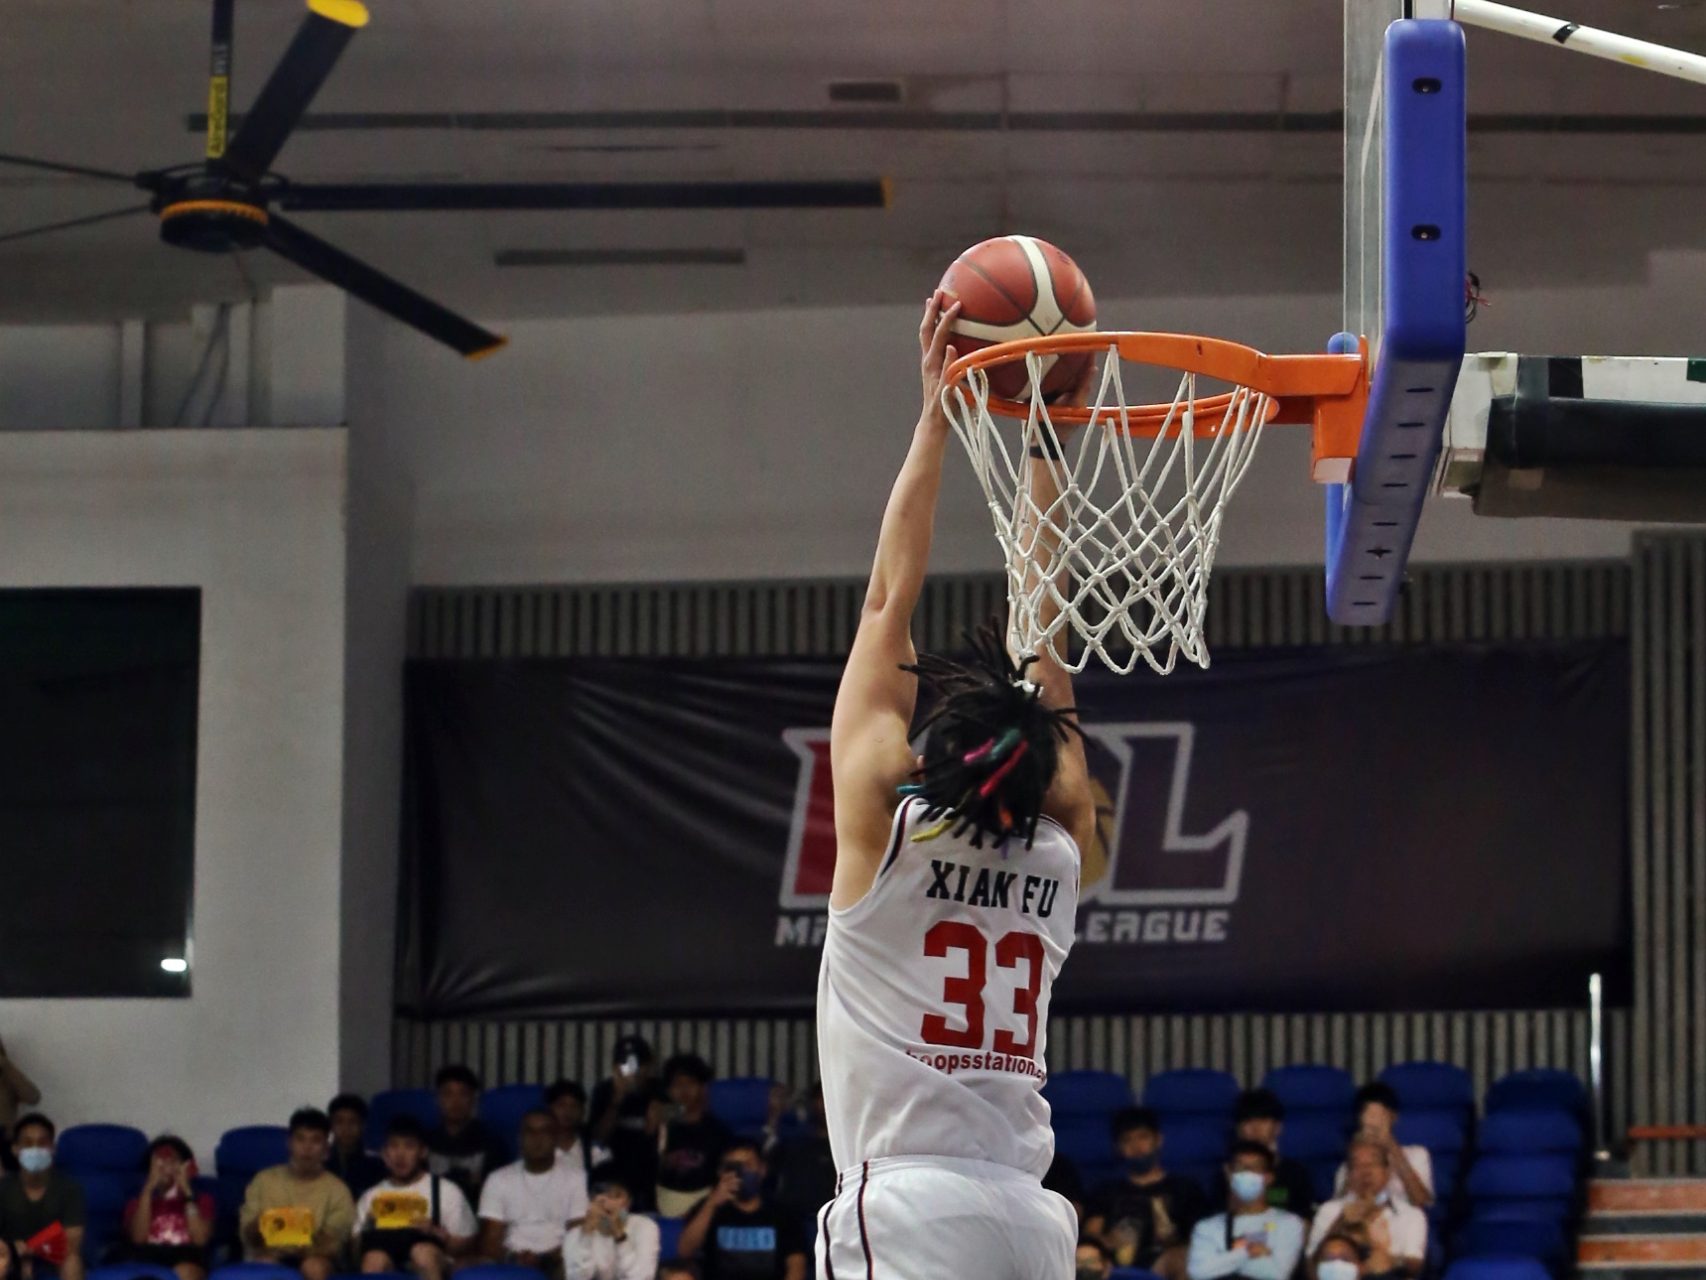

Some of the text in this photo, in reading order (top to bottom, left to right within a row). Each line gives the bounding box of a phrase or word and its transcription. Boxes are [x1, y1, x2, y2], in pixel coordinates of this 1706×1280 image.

[926, 859, 1059, 918] XIAN FU
[1075, 910, 1230, 943] EAGUE
[920, 921, 1045, 1057] 33
